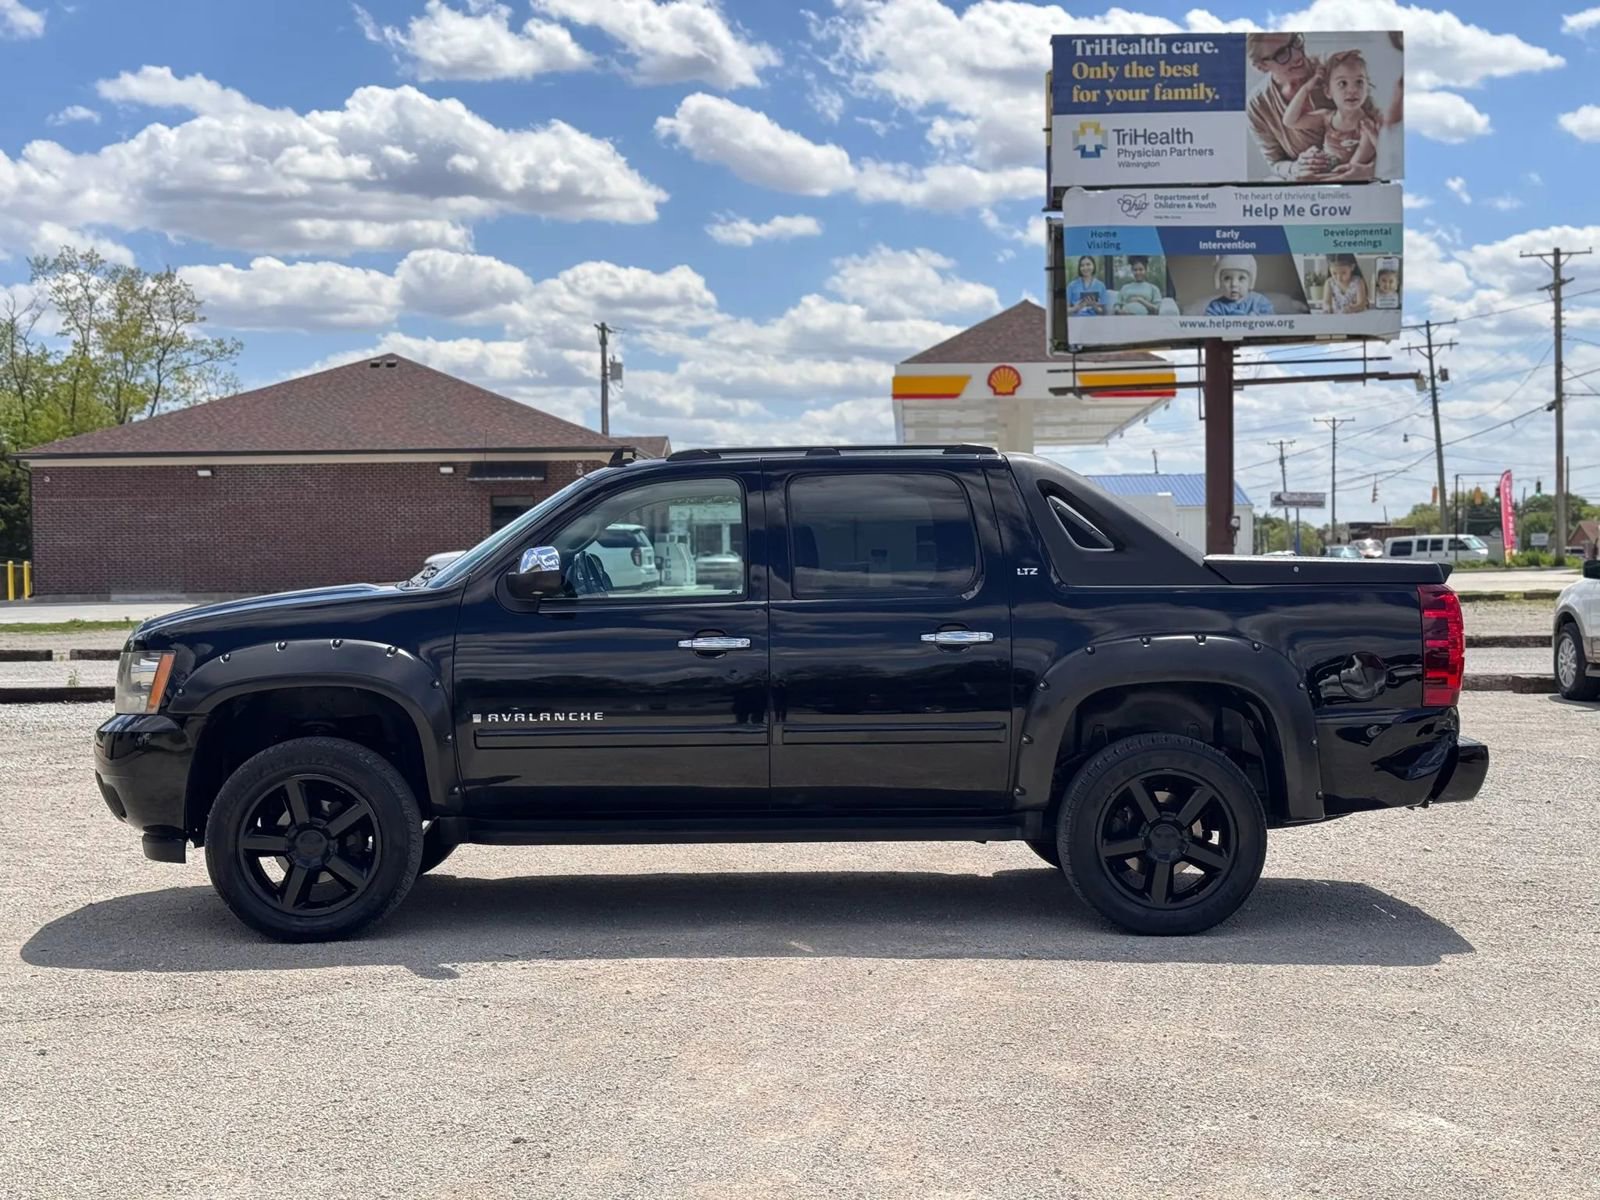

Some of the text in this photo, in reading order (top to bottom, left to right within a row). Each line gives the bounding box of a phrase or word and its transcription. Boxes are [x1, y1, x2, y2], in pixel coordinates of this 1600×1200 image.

[1072, 37, 1219, 56] TriHealth care.
[1072, 60, 1199, 82] Only the best
[1072, 82, 1220, 106] for your family.
[1112, 127, 1194, 145] TriHealth
[1117, 147, 1214, 160] Physician Partners
[1118, 160, 1160, 169] Wilmington
[1154, 193, 1209, 203] Department of
[1234, 192, 1249, 200] The
[1250, 192, 1273, 200] heart
[1274, 192, 1283, 200] of
[1284, 192, 1317, 201] thriving
[1242, 203, 1352, 221] Help Me Grow
[1090, 230, 1117, 238] Home
[1215, 229, 1240, 240] Early
[1323, 227, 1392, 238] Developmental
[1087, 240, 1121, 250] Visiting
[1199, 241, 1257, 250] Intervention
[1332, 237, 1383, 249] Screenings
[1179, 319, 1295, 330] www.helpmegrow.org
[1016, 567, 1039, 576] LTZ
[487, 711, 604, 722] AVALANCHE
